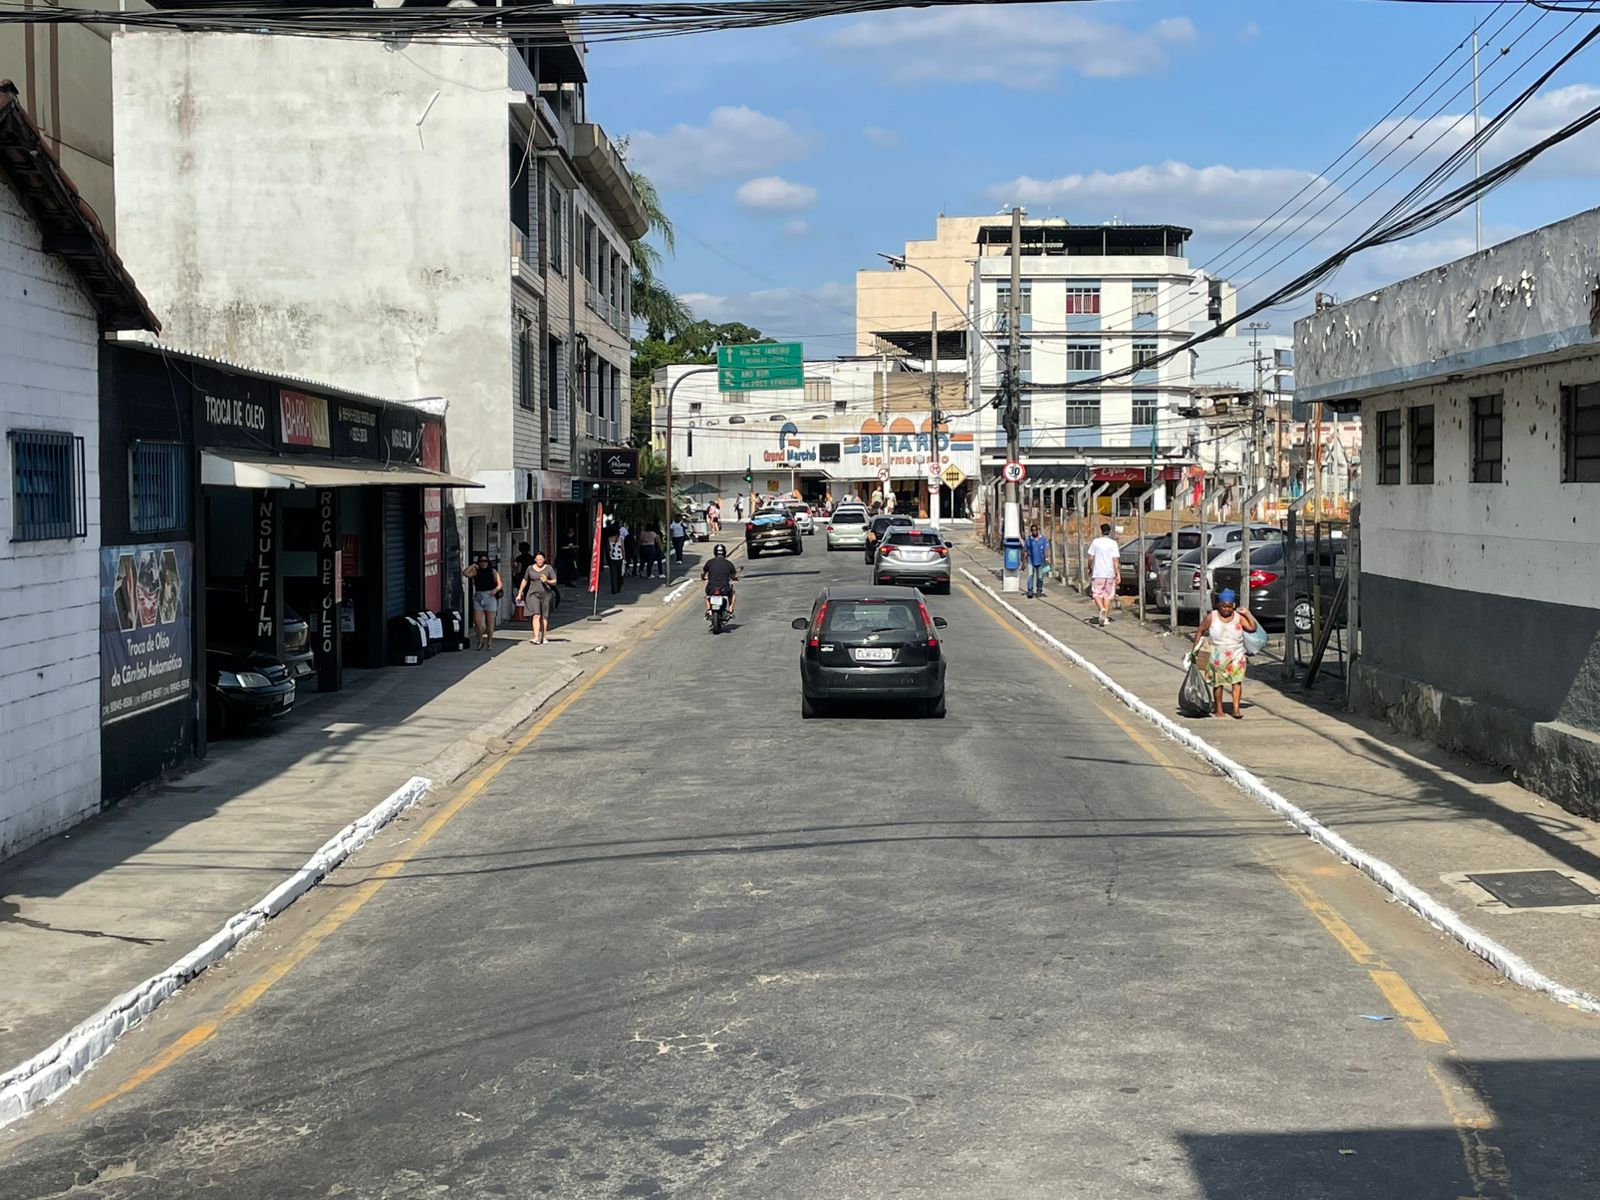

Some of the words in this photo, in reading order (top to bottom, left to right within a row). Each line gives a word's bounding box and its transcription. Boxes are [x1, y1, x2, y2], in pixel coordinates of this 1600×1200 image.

[205, 395, 231, 425] TROCA
[233, 400, 243, 426] DE
[245, 392, 265, 430] ÓLEO
[285, 396, 312, 438] BARRA
[763, 449, 785, 462] Grand
[787, 446, 816, 462] Marché
[1008, 466, 1020, 476] 30
[321, 489, 332, 548] ROCA
[258, 487, 273, 637] INSULFILM
[322, 559, 333, 585] DE
[322, 592, 333, 653] ÓLEO
[126, 638, 146, 656] Troca
[146, 633, 154, 652] de
[111, 666, 121, 687] do
[148, 653, 183, 677] Automático
